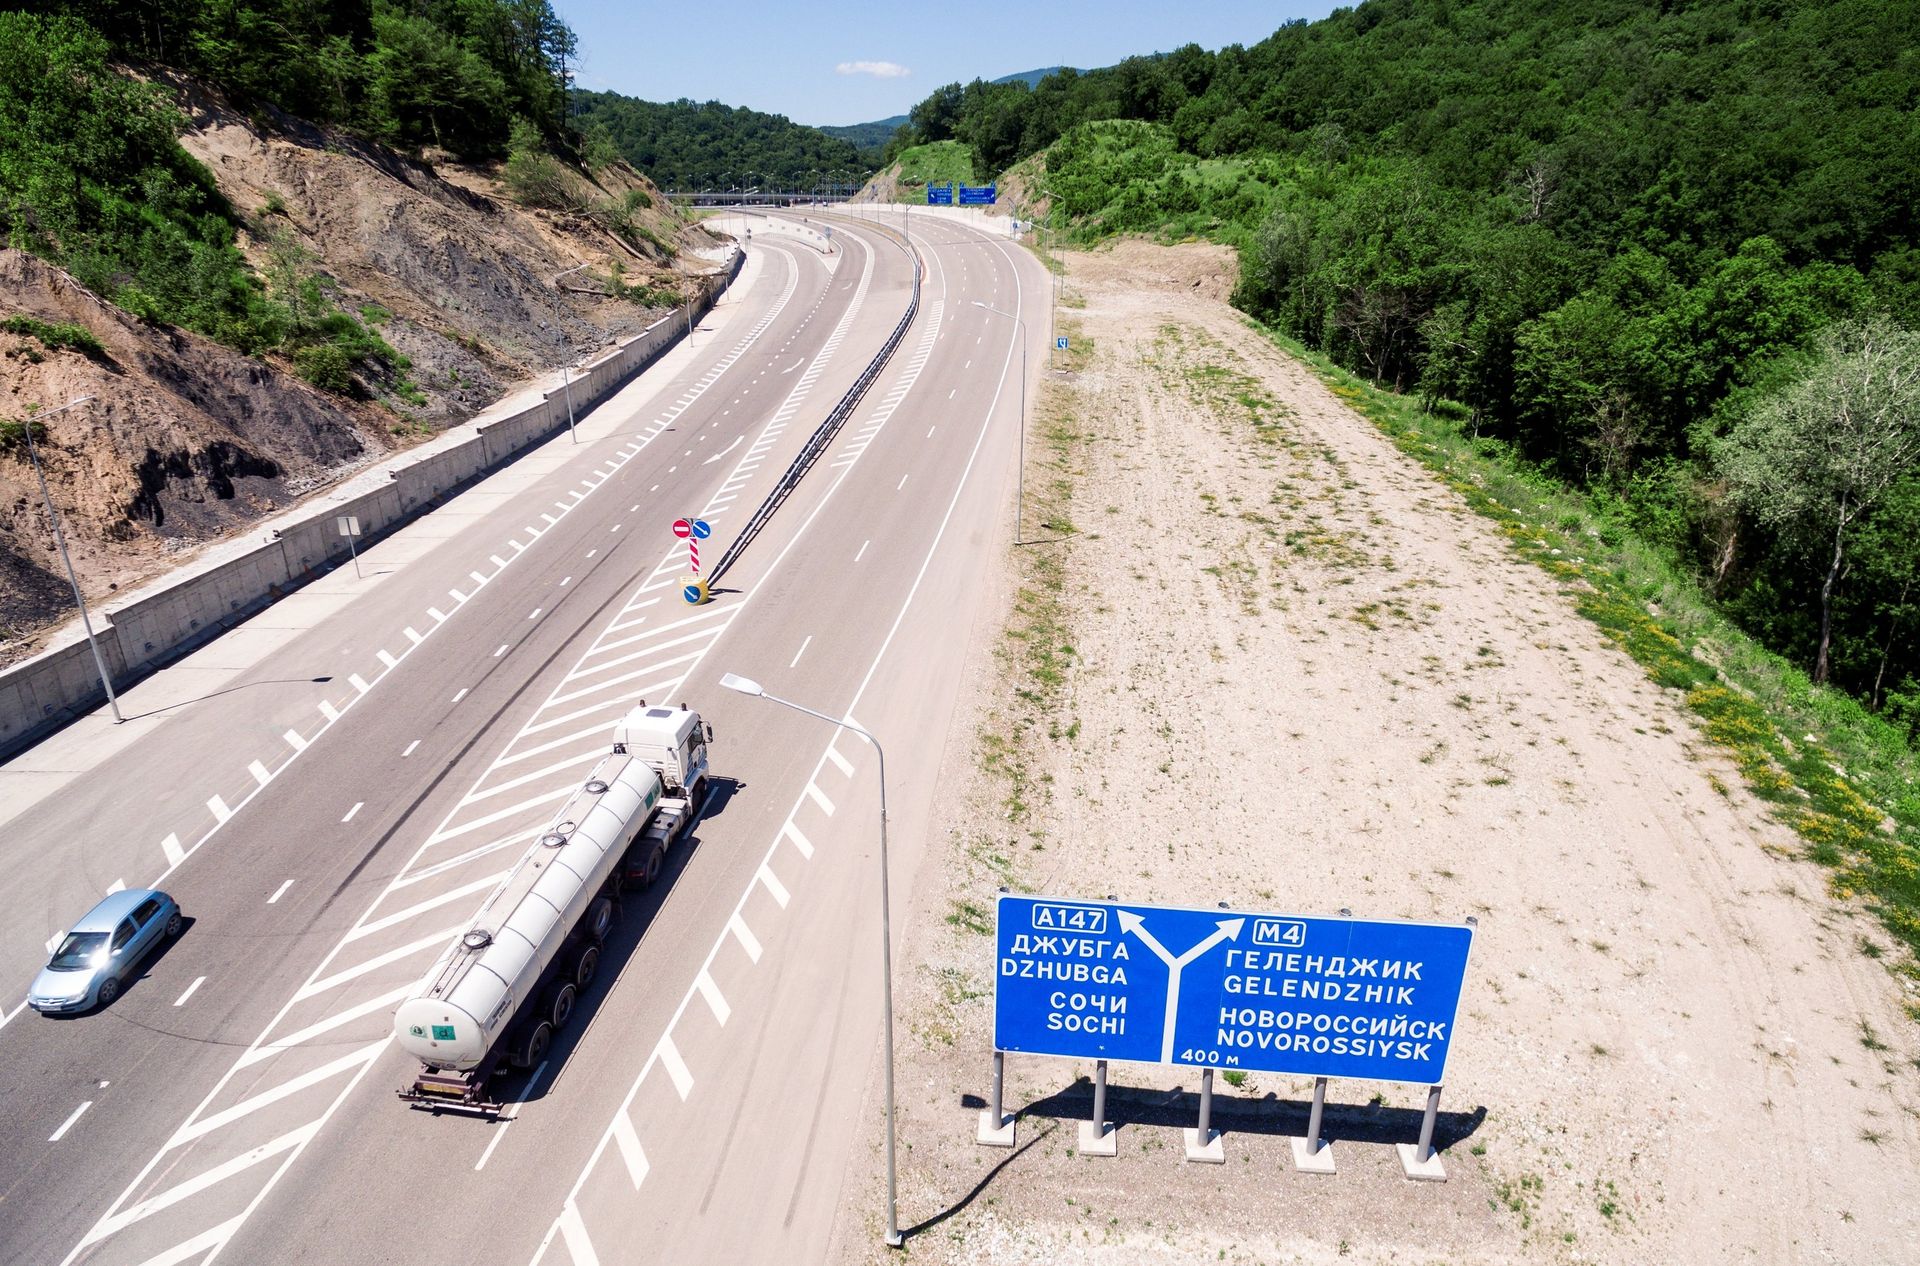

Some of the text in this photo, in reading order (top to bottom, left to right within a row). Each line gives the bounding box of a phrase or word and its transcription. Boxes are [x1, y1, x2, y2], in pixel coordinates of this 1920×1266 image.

[1010, 934, 1130, 961] ДЖУБГА
[1001, 958, 1128, 985] DZHUBGA
[1226, 949, 1423, 981] ГЕЛЕНДЖИК
[1050, 991, 1127, 1014] СОЧИ
[1224, 975, 1415, 1006] GELENDZHIK
[1047, 1012, 1125, 1035] SOCHI
[1219, 1007, 1446, 1041] НОВОРОССИЙСК
[1180, 1048, 1220, 1064] 400
[1217, 1028, 1432, 1061] NOVOROSSIYSK
